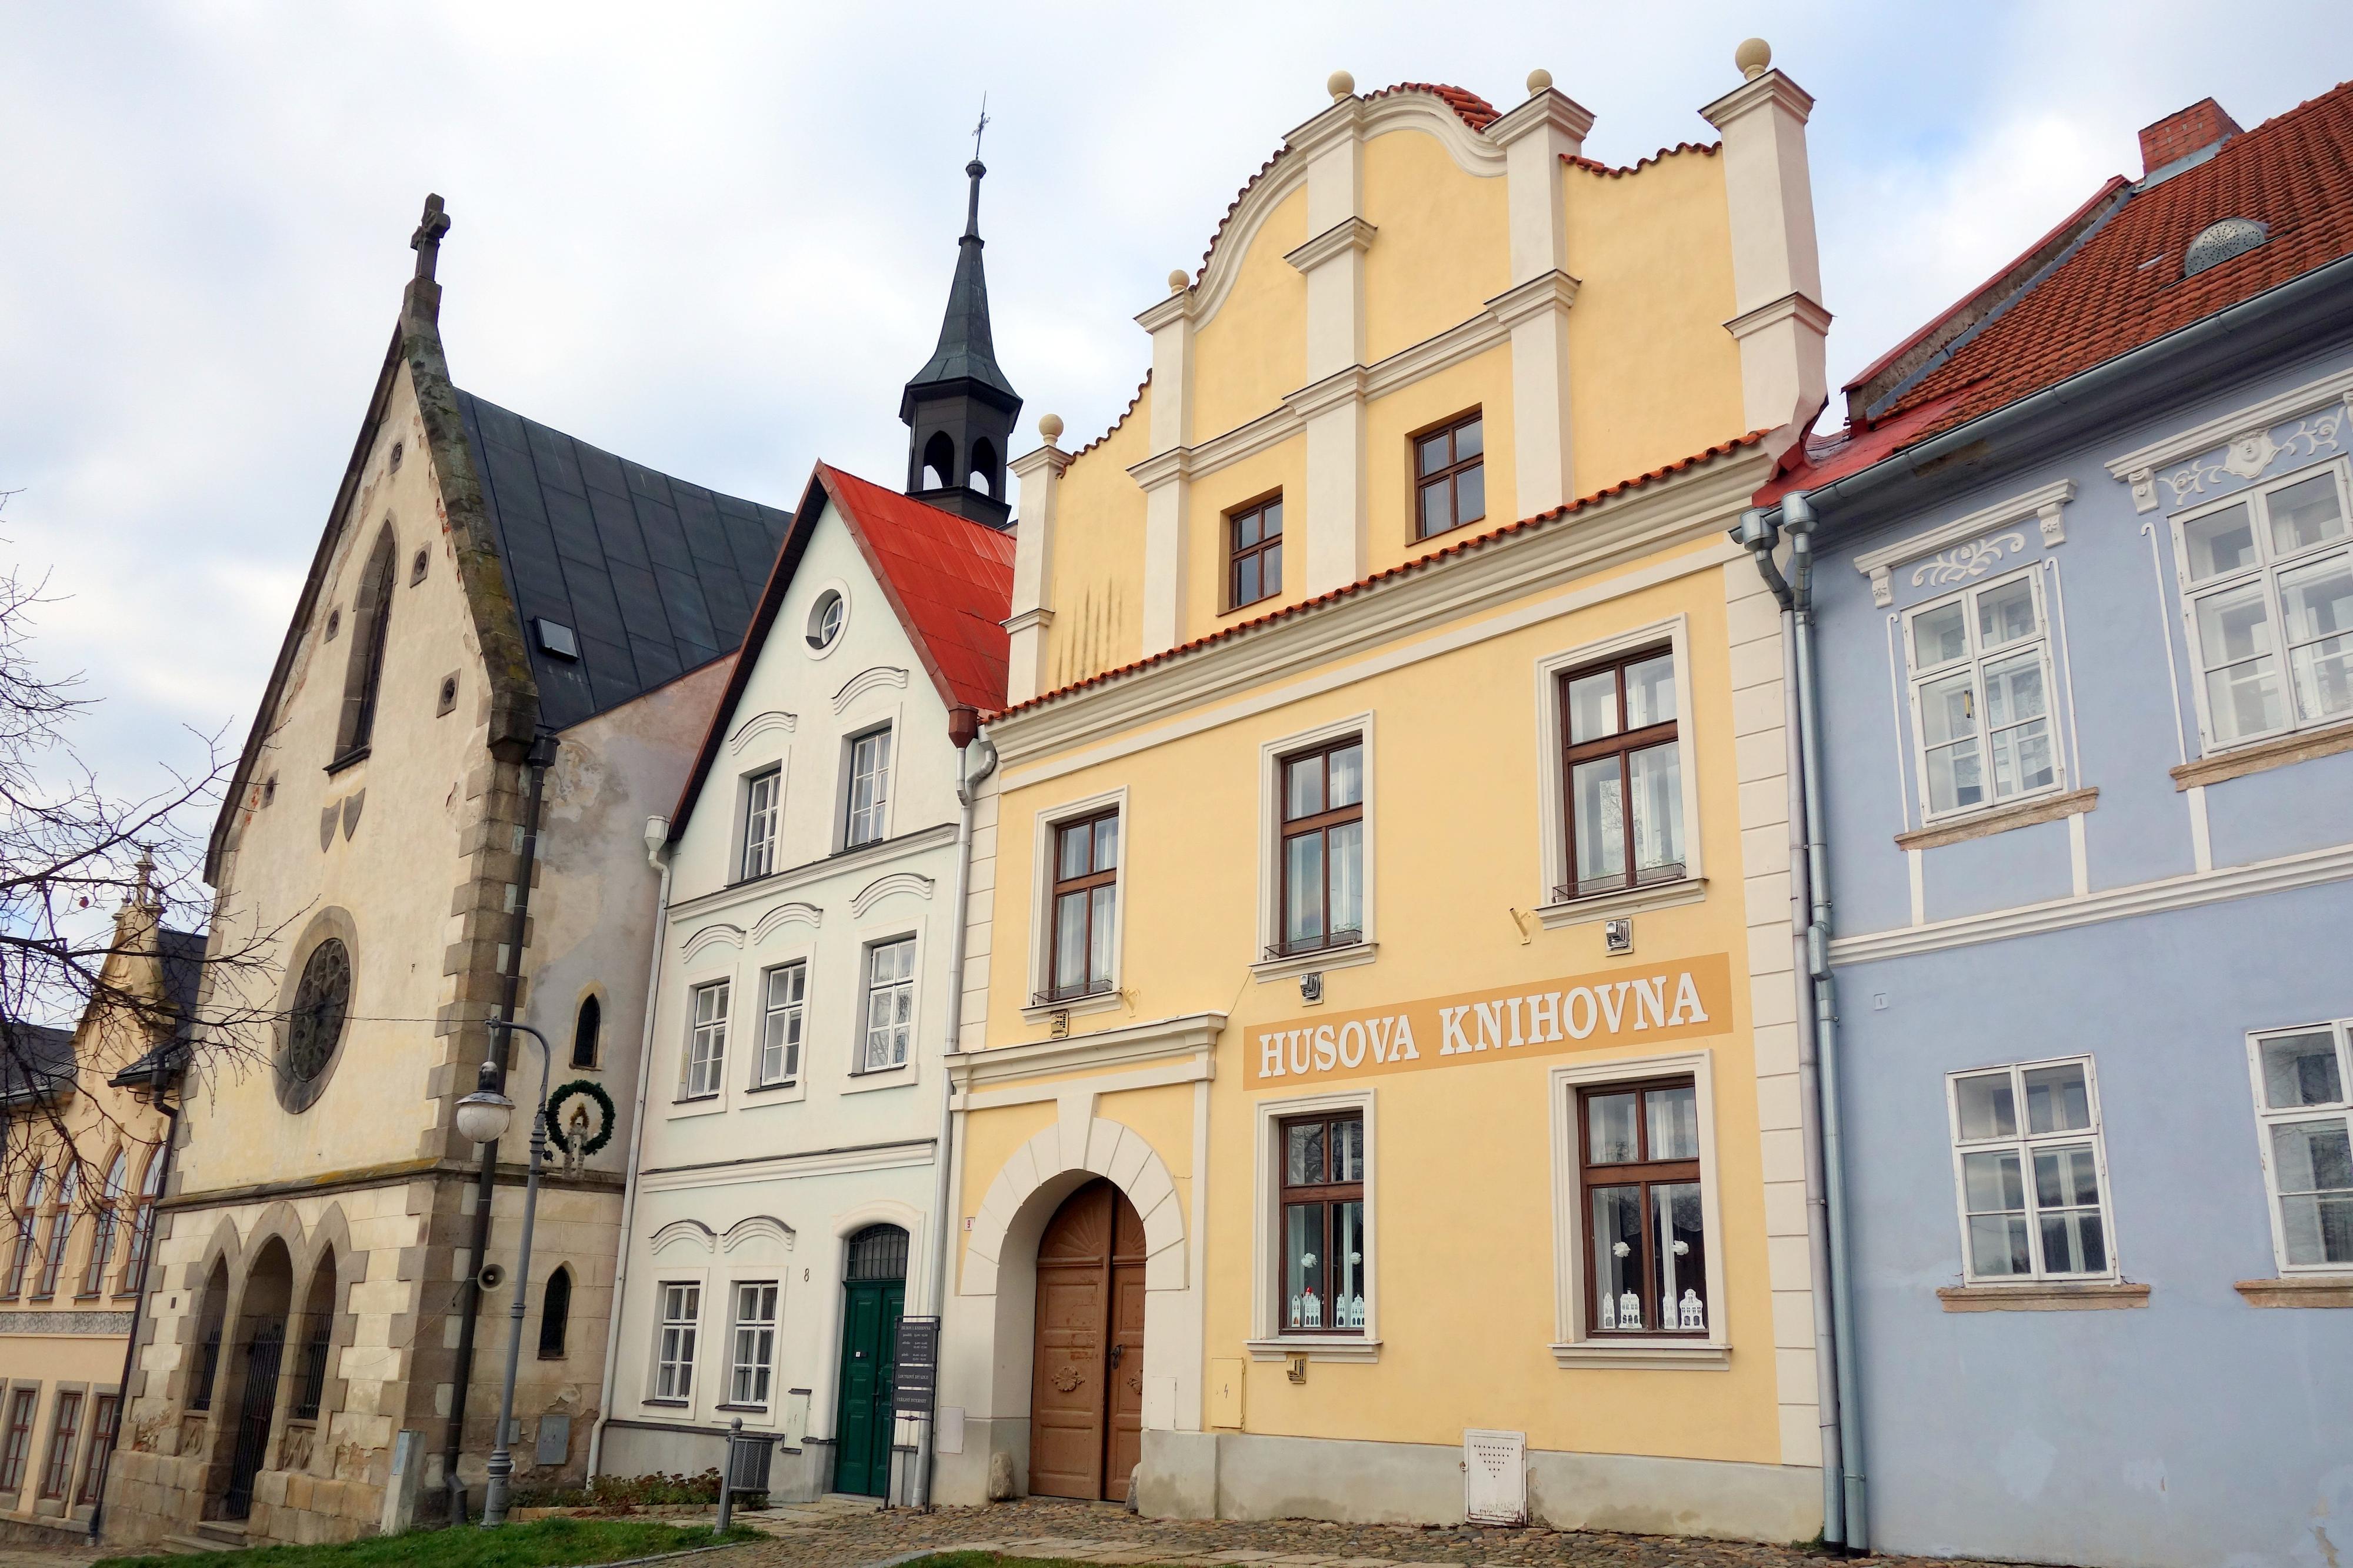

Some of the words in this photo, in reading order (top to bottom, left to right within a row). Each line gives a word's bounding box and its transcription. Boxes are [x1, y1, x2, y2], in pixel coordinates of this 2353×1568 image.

[1258, 1014, 1421, 1079] HUSOVA
[1439, 972, 1709, 1056] KNIHOVNA
[967, 1219, 971, 1228] 9
[804, 1268, 809, 1282] 8
